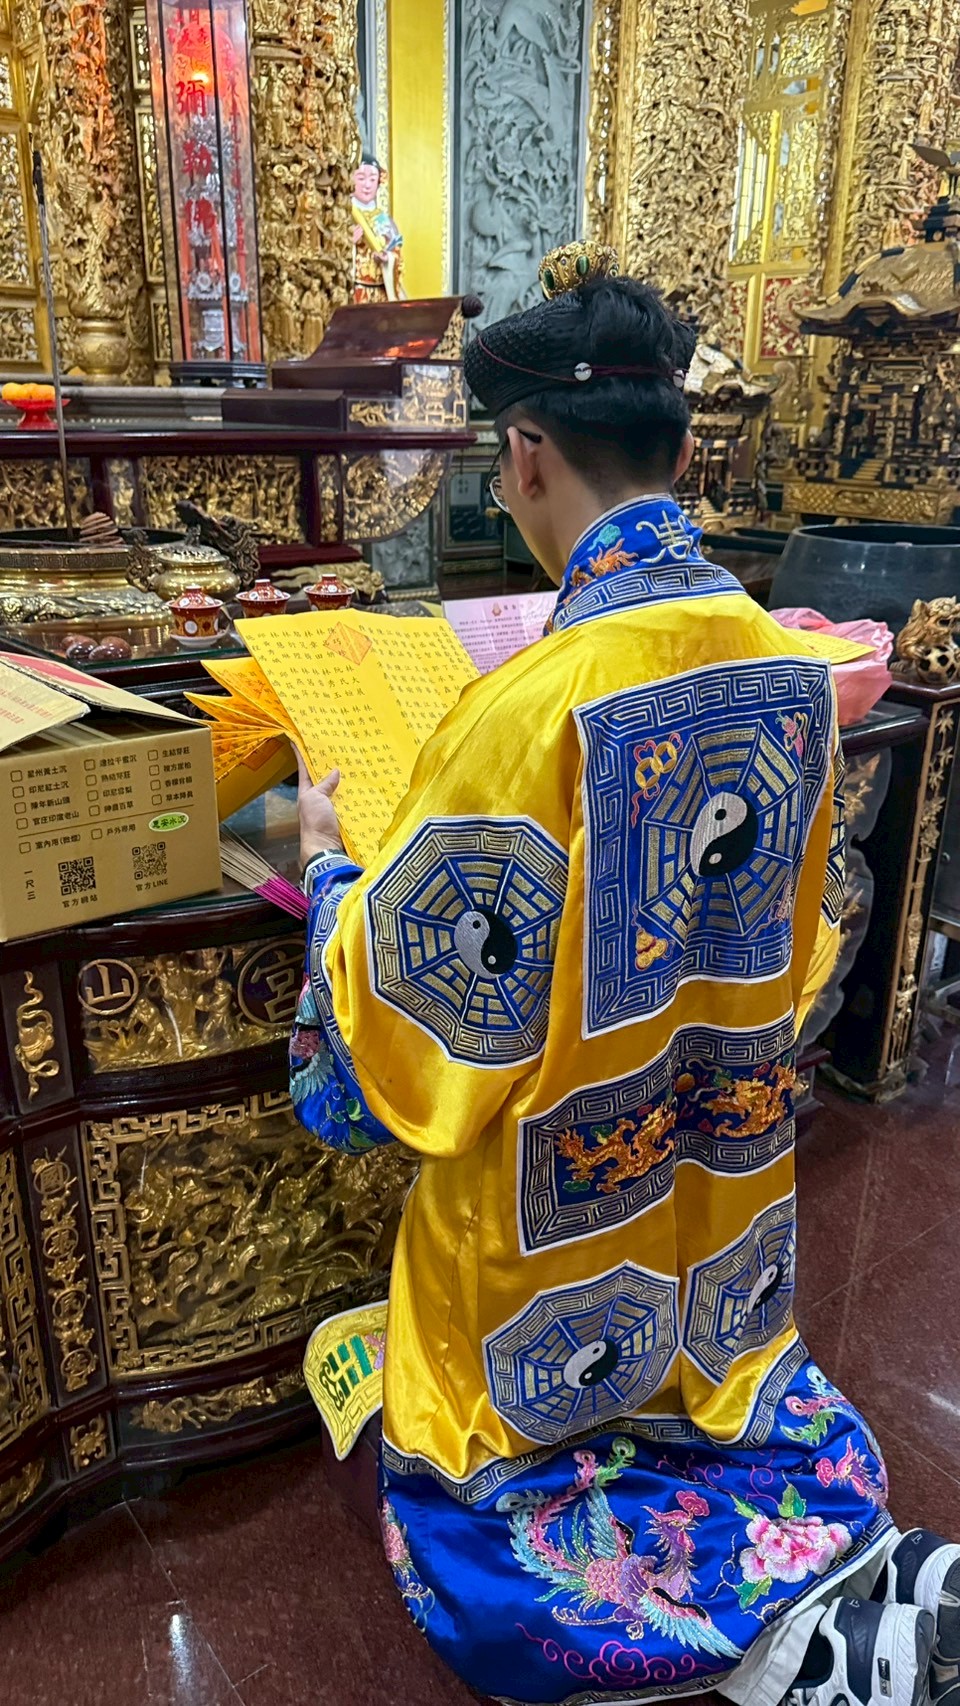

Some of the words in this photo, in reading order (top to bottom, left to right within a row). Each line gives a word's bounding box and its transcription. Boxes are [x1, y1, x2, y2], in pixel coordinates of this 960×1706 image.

[24, 869, 36, 901] 一尺三
[153, 878, 169, 888] LINE
[62, 893, 98, 908] 官方網站
[84, 964, 131, 1006] 山
